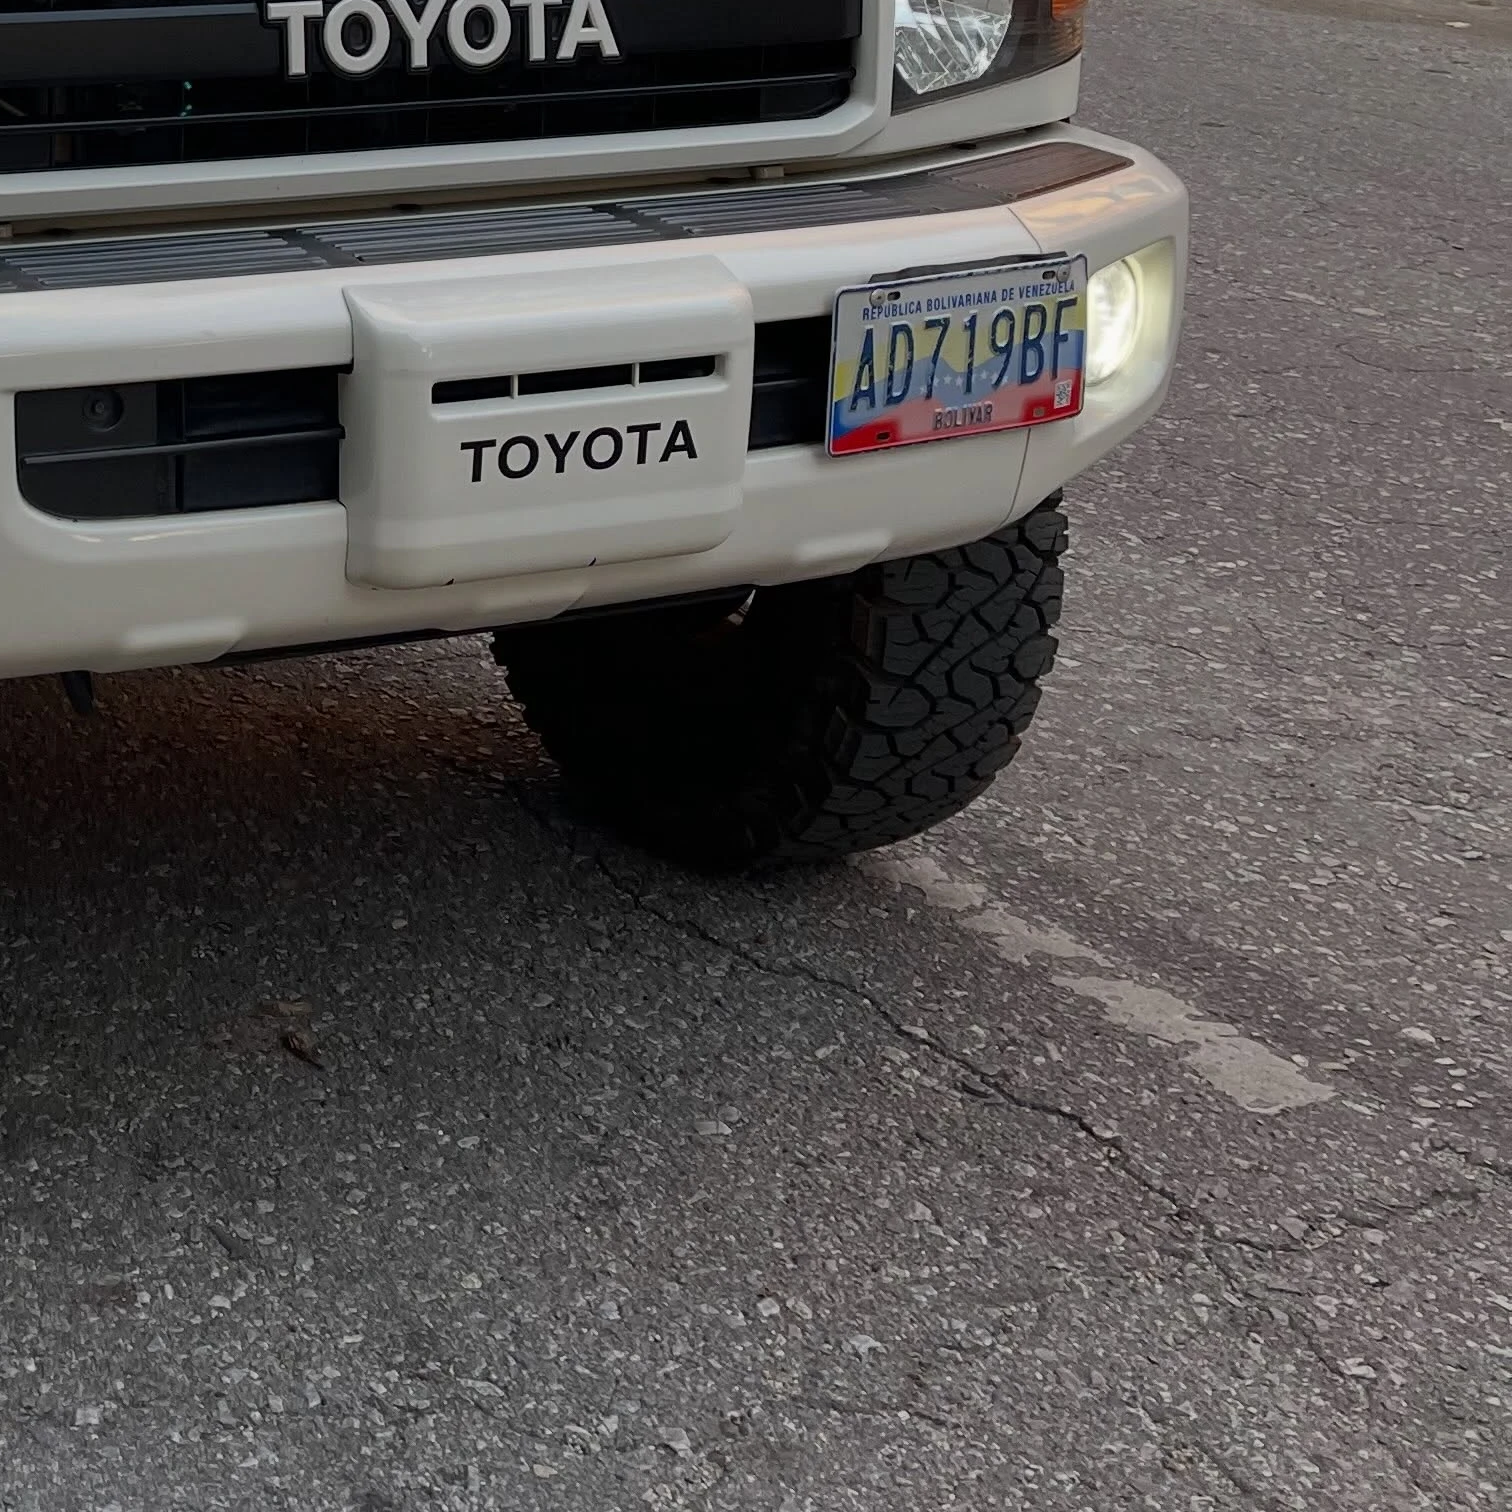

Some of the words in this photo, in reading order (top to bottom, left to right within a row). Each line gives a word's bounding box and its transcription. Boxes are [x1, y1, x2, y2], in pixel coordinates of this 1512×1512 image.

[926, 291, 997, 312] BOLIVARIANA
[1001, 288, 1015, 301] DE
[1019, 280, 1075, 299] VENEZUELA
[849, 296, 1079, 412] AD719BF
[934, 404, 994, 431] BOLIVAR
[460, 420, 698, 482] TOYOTA
